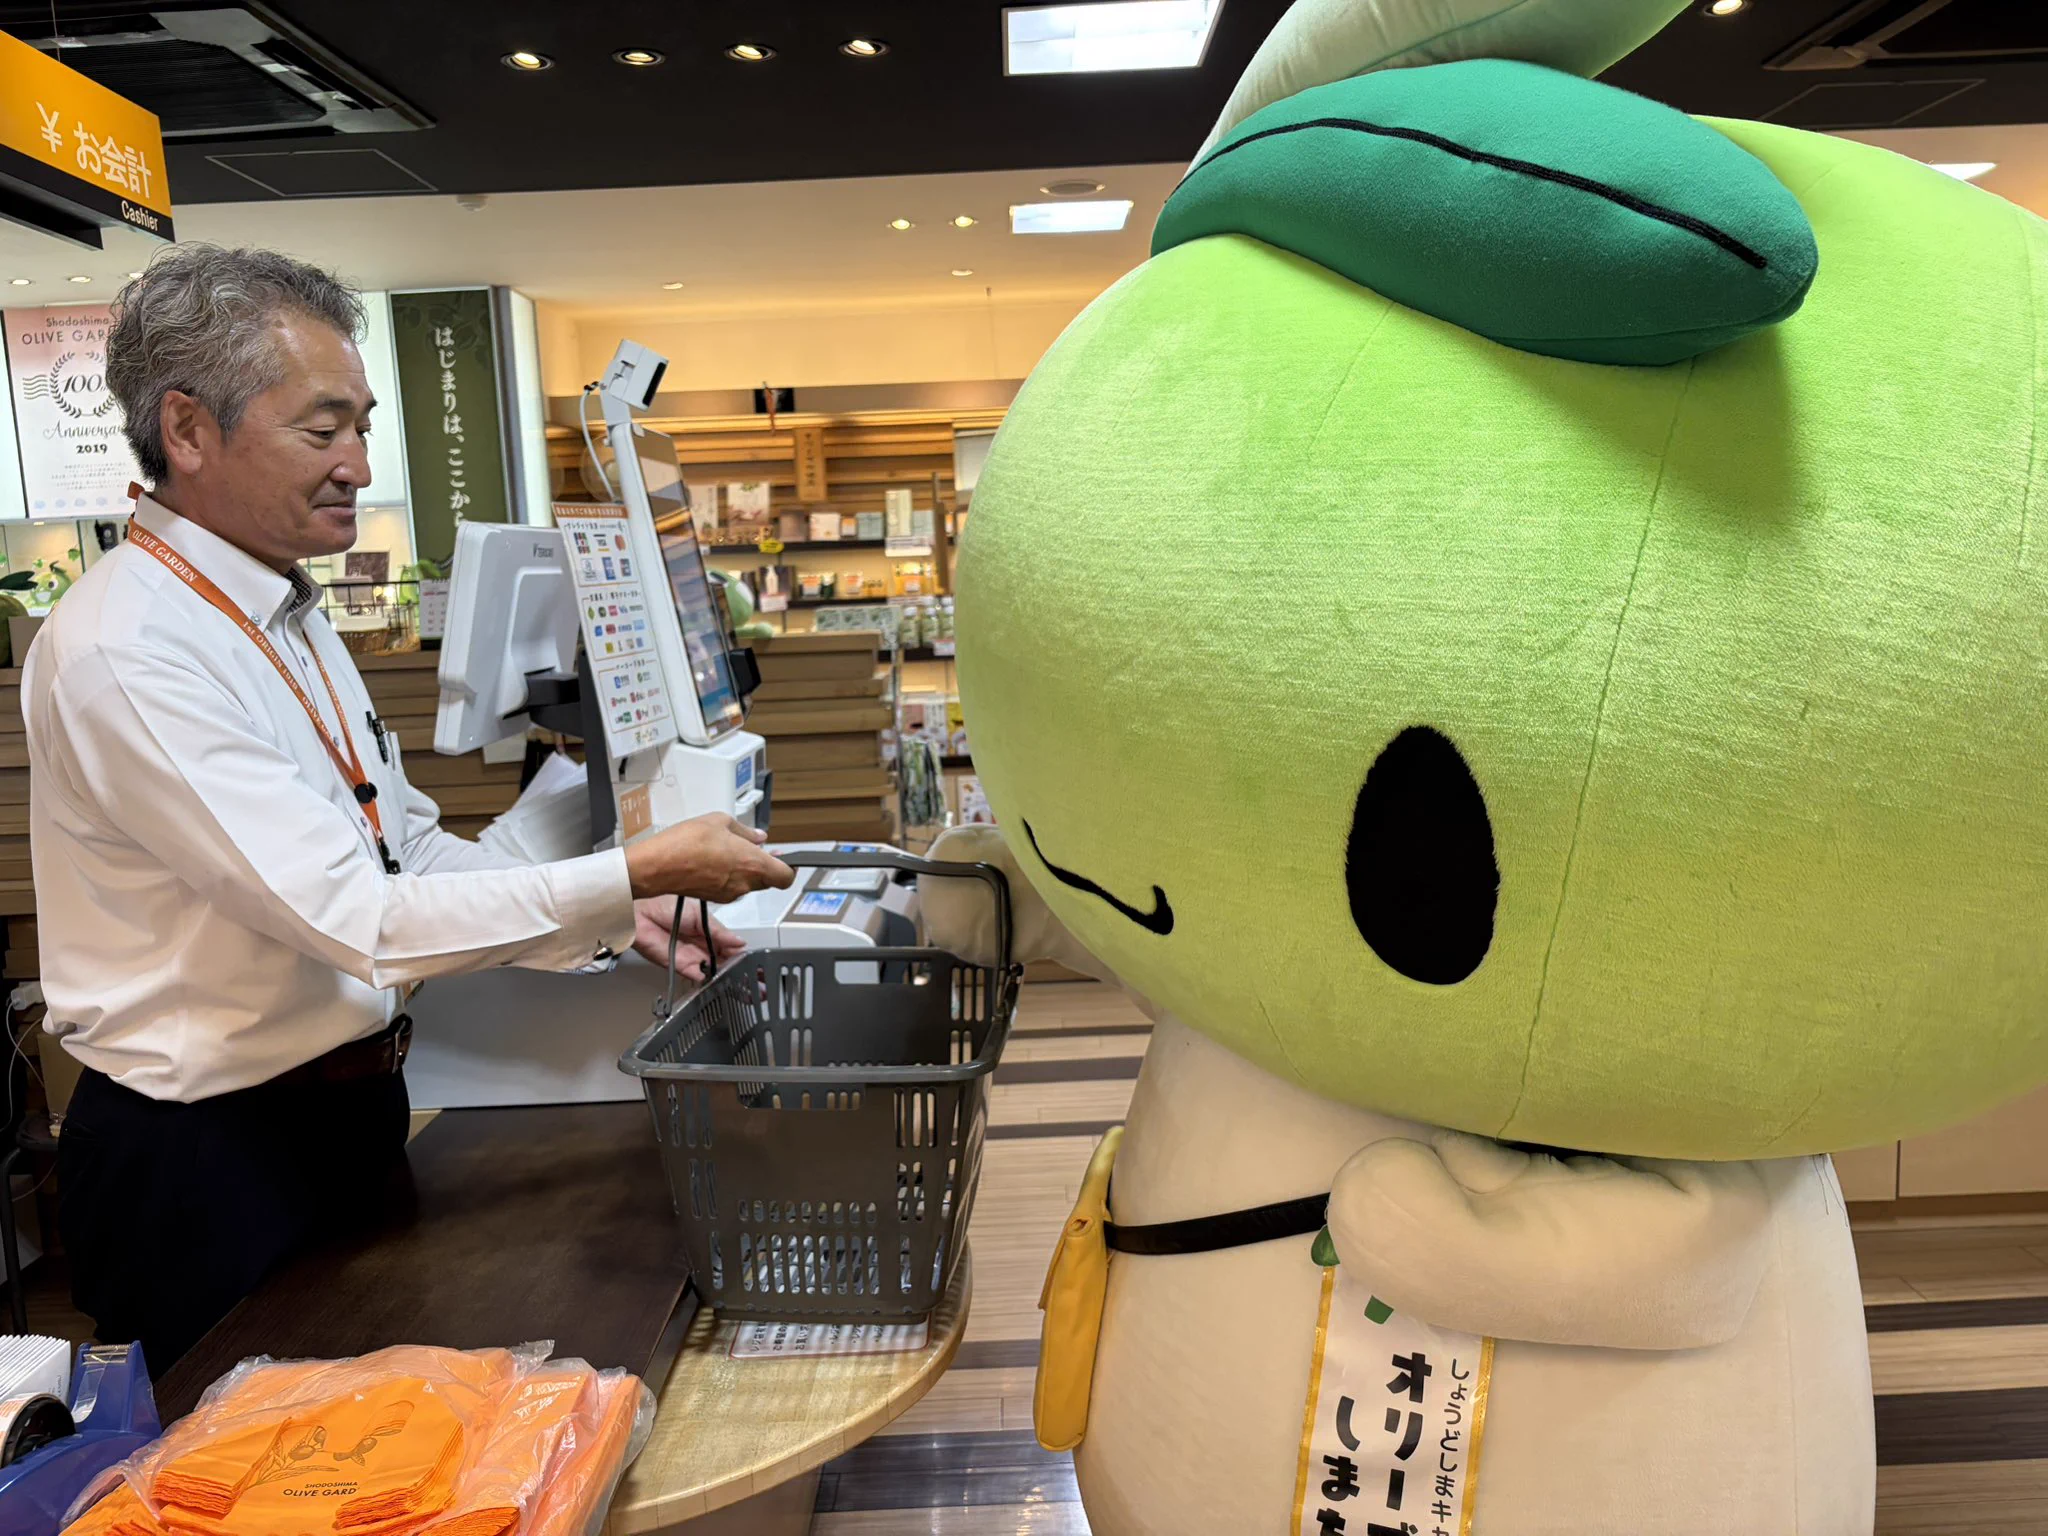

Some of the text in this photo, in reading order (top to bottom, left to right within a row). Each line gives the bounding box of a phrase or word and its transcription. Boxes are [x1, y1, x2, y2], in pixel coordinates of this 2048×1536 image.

[73, 121, 152, 199] お会計
[121, 200, 158, 231] Cashier
[46, 316, 109, 328] Shodoshima
[22, 329, 107, 345] OLIVE GAR
[76, 443, 108, 454] 2019
[133, 529, 198, 582] OLIVE GARDEN
[243, 620, 255, 635] 1st
[283, 1488, 358, 1497] OLIVE GARD
